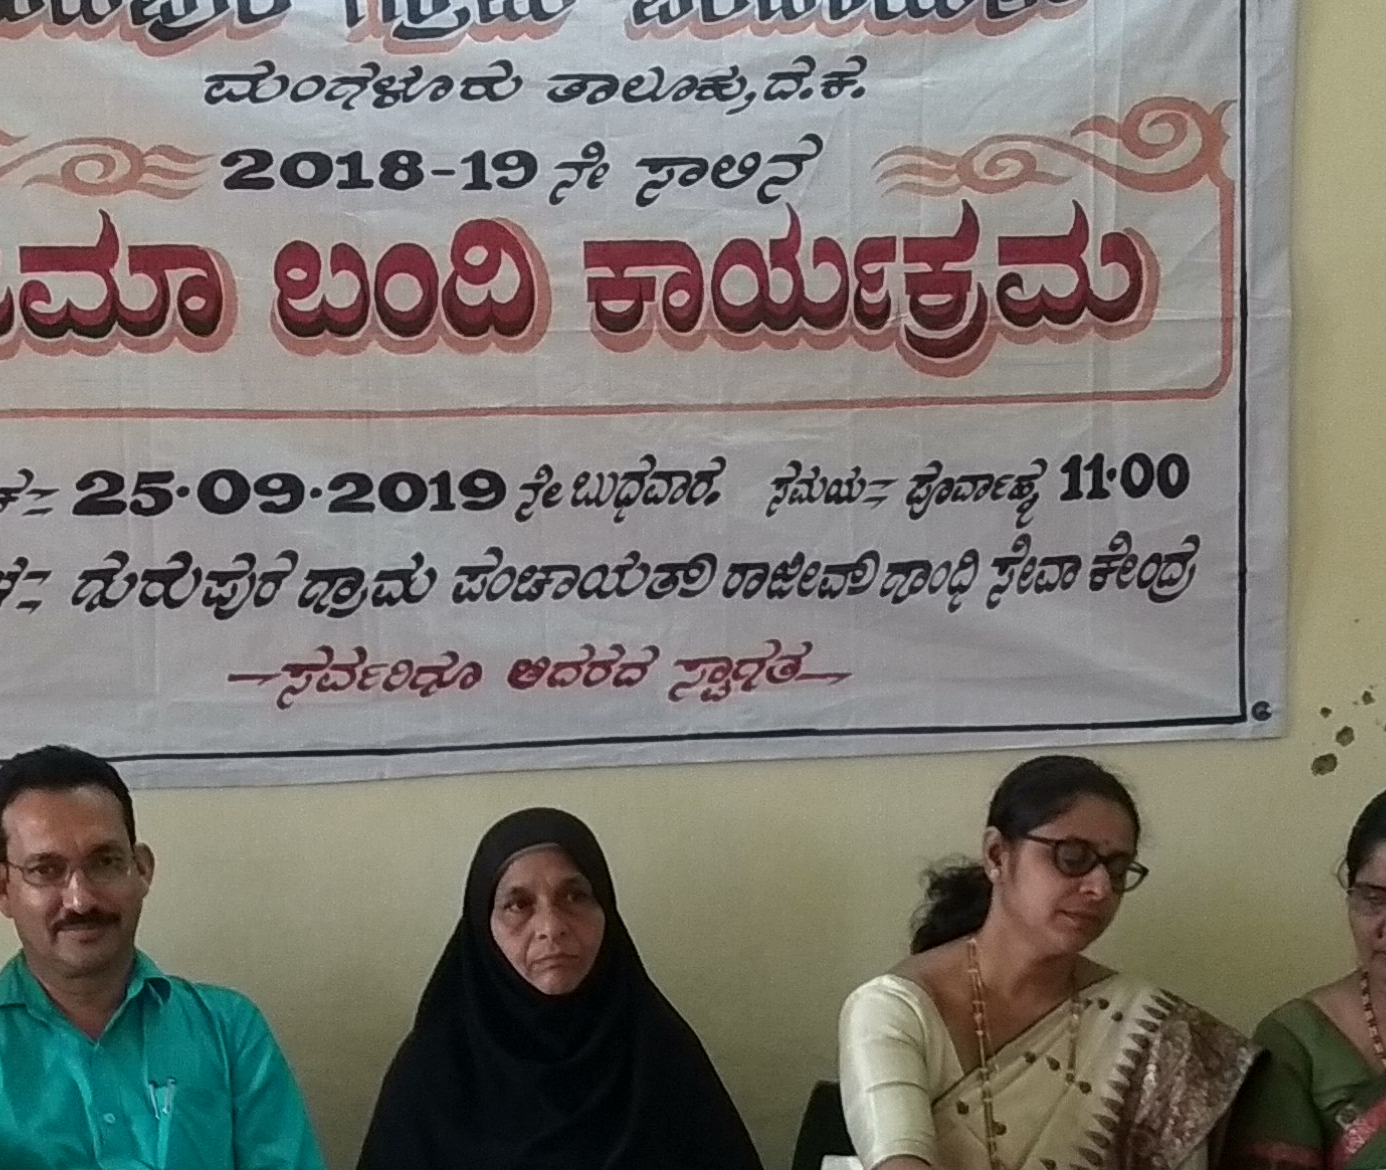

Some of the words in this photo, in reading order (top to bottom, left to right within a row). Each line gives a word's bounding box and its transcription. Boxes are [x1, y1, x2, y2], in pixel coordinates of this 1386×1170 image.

[204, 60, 523, 111] ಮಂಗಳೂರು
[220, 149, 539, 191] 2018-19
[549, 141, 610, 205] ನೇ
[635, 133, 824, 207] ಸಾಲಿನ
[274, 217, 539, 342] ಬಂದಿ
[583, 199, 1147, 361] ಕಾರ್ಯಕ್ರಮ
[514, 464, 563, 522] ನೇ
[71, 550, 298, 620] ಗುರುಪುರ
[297, 551, 437, 618] ಗ್ರಾಮ
[451, 546, 718, 602] ಪಂಚಾಯತ್
[722, 550, 881, 600] ರಾಜೀವ್
[879, 548, 980, 613] ಗಾಂಧಿ
[985, 533, 1082, 610] ಸೇವಾ
[1088, 530, 1201, 604] ಕೇಂದ್ರ
